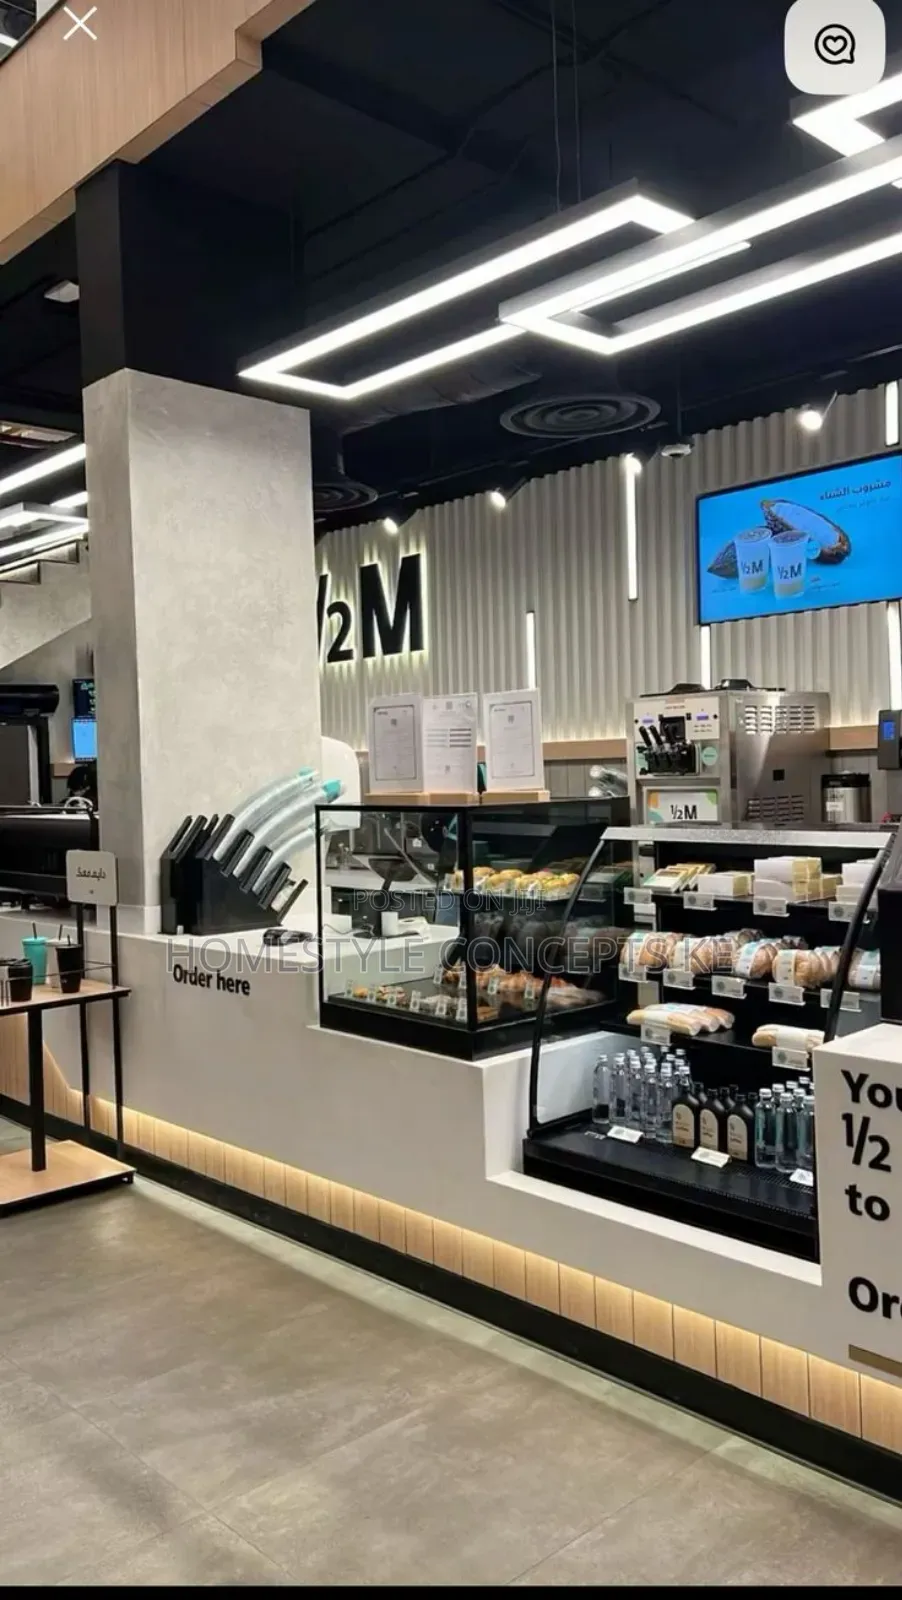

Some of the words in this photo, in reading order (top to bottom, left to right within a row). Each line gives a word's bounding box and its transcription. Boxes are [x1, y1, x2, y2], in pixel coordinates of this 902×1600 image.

[173, 963, 214, 989] Order
[216, 969, 251, 996] here
[844, 1183, 891, 1222] to
[848, 1276, 902, 1320] Or
